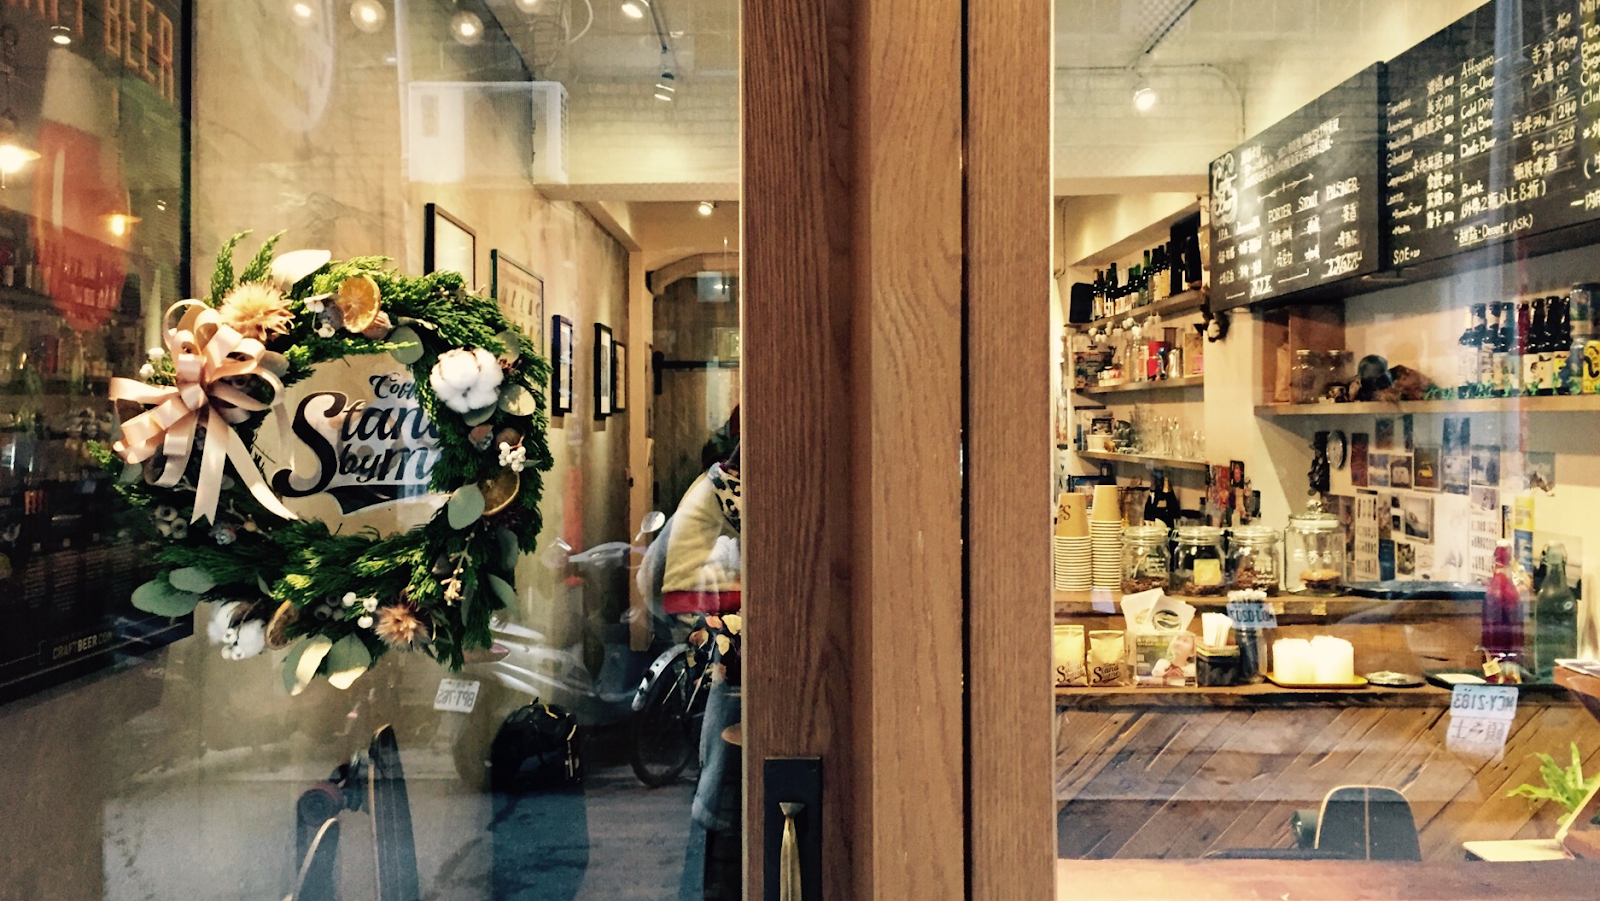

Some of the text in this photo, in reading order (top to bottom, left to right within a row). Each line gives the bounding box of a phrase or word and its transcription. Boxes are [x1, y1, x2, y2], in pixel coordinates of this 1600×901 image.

[104, 0, 175, 106] BEER
[1558, 101, 1576, 119] 240
[1268, 203, 1292, 223] PORTER
